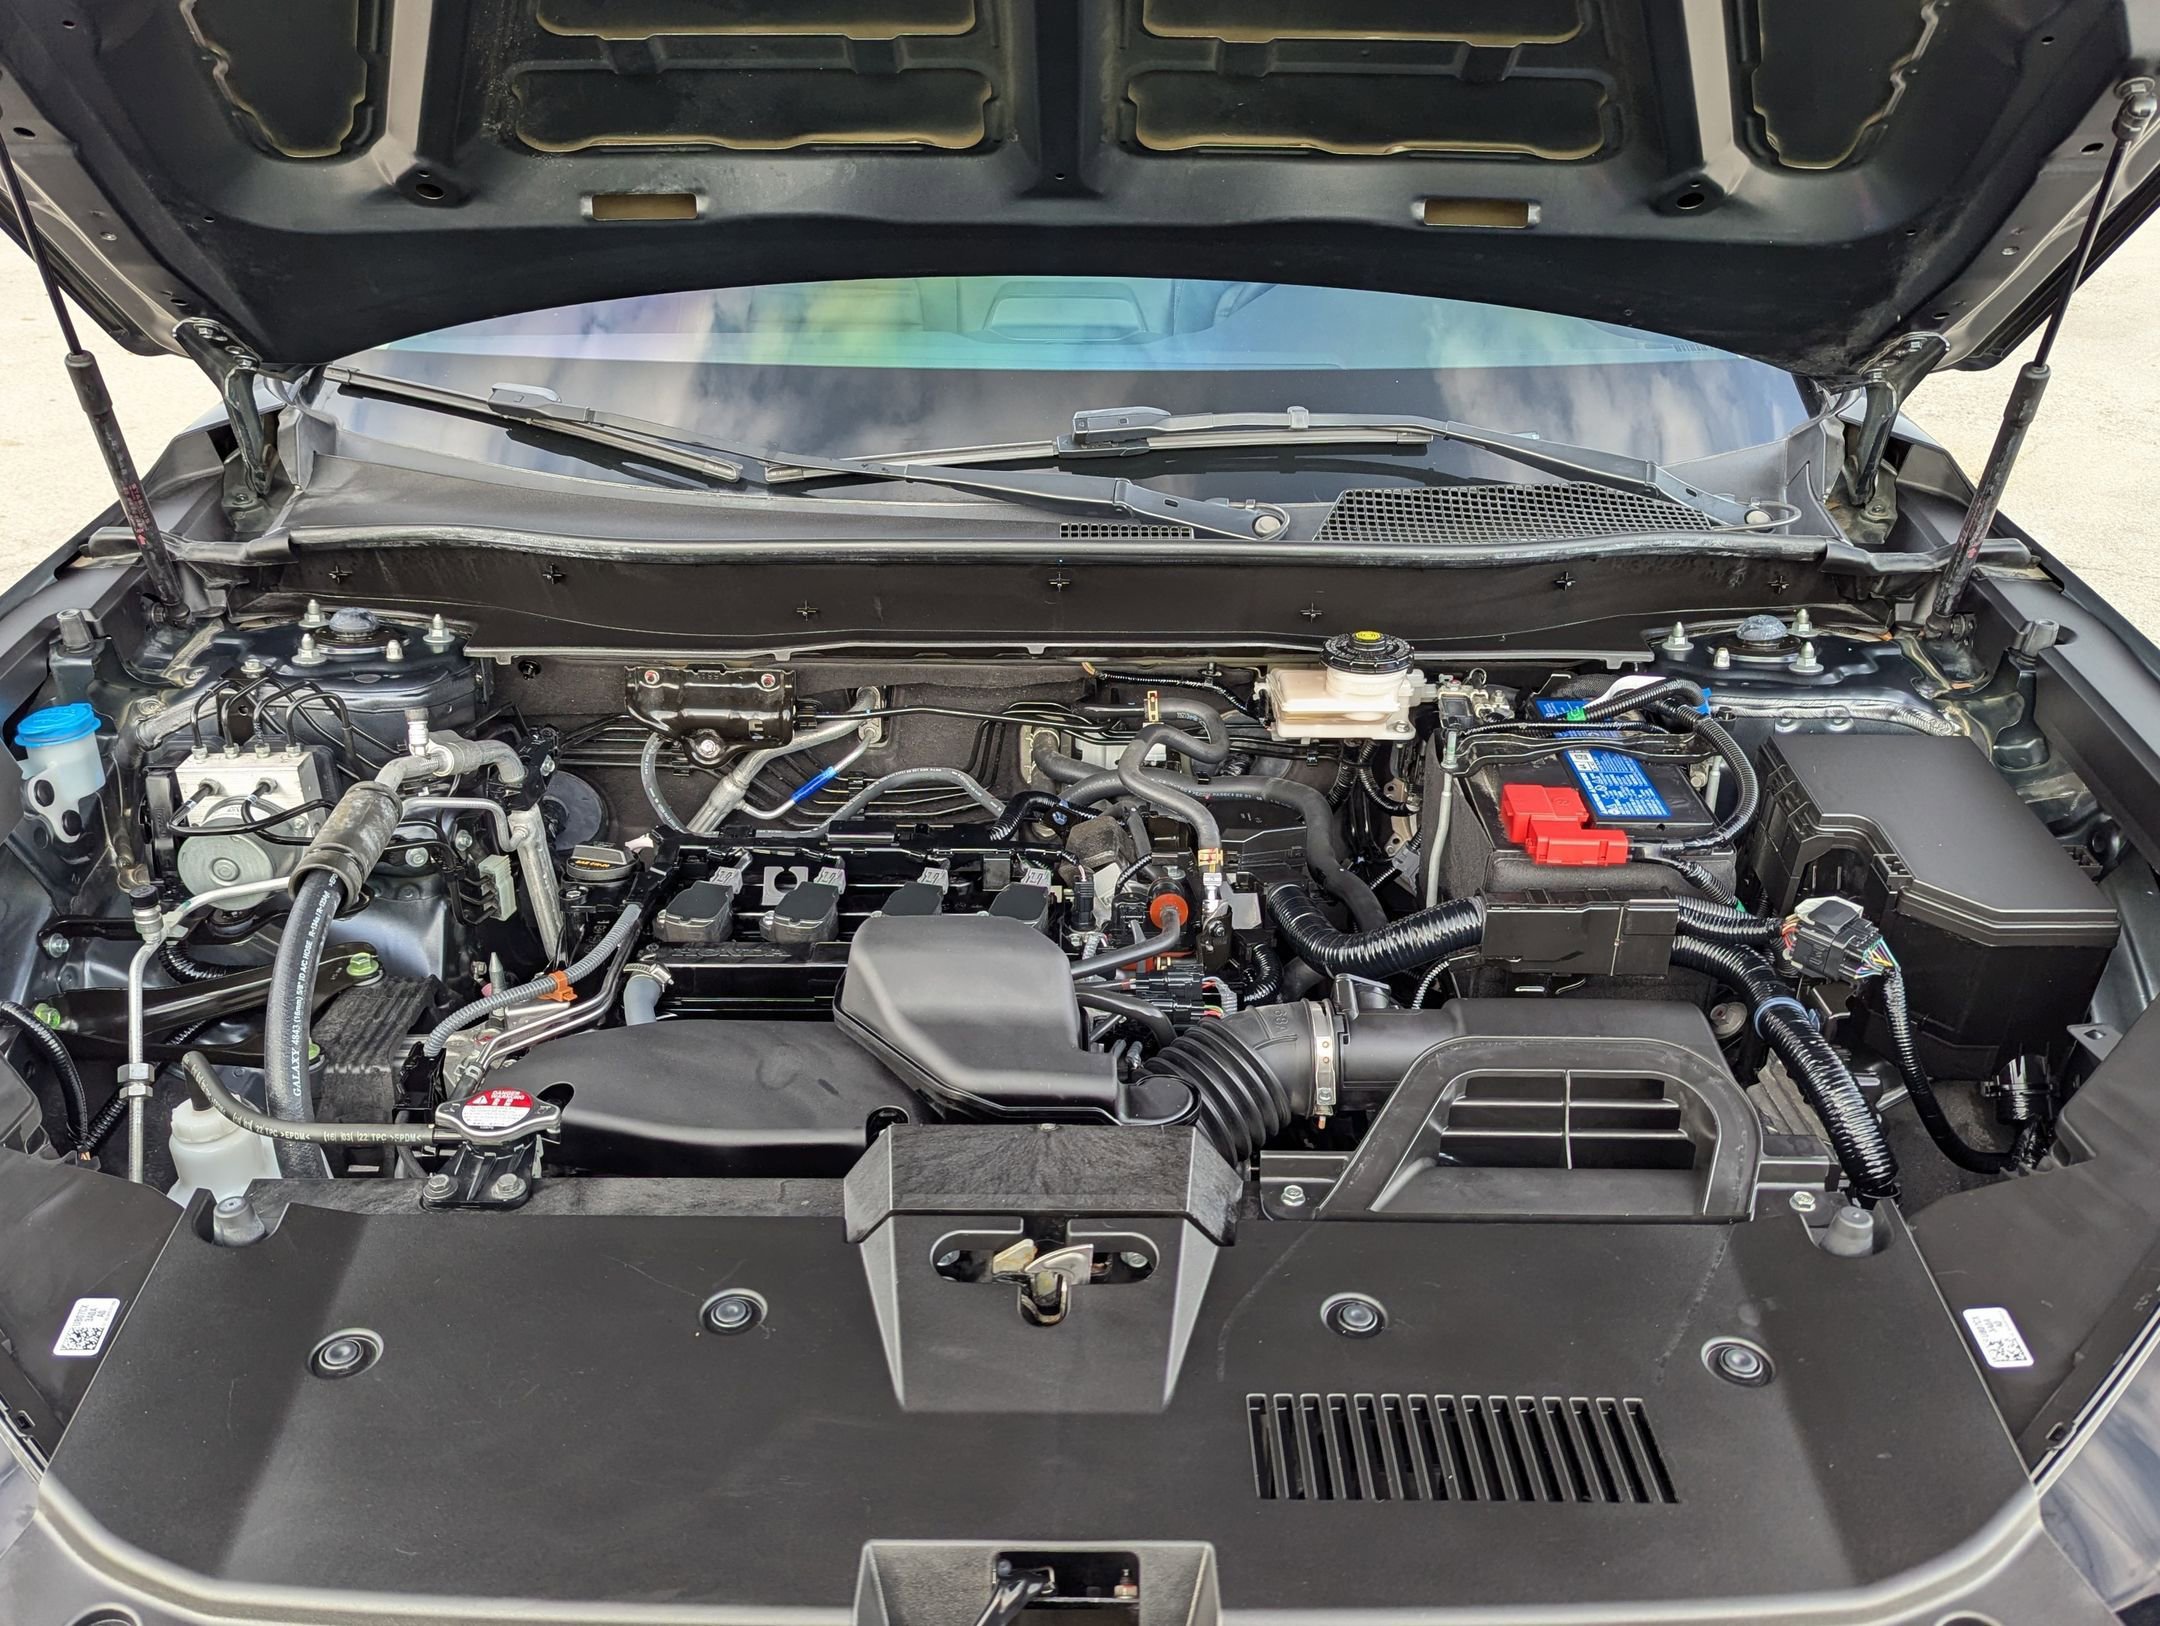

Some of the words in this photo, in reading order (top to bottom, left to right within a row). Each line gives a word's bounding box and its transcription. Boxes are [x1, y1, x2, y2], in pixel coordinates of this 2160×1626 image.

[131, 483, 150, 524] STABILUS
[303, 939, 313, 960] HOSE
[300, 959, 308, 973] A/C
[291, 1024, 301, 1046] 4843
[291, 1047, 302, 1097] GALAXY
[371, 1133, 387, 1142] TPC
